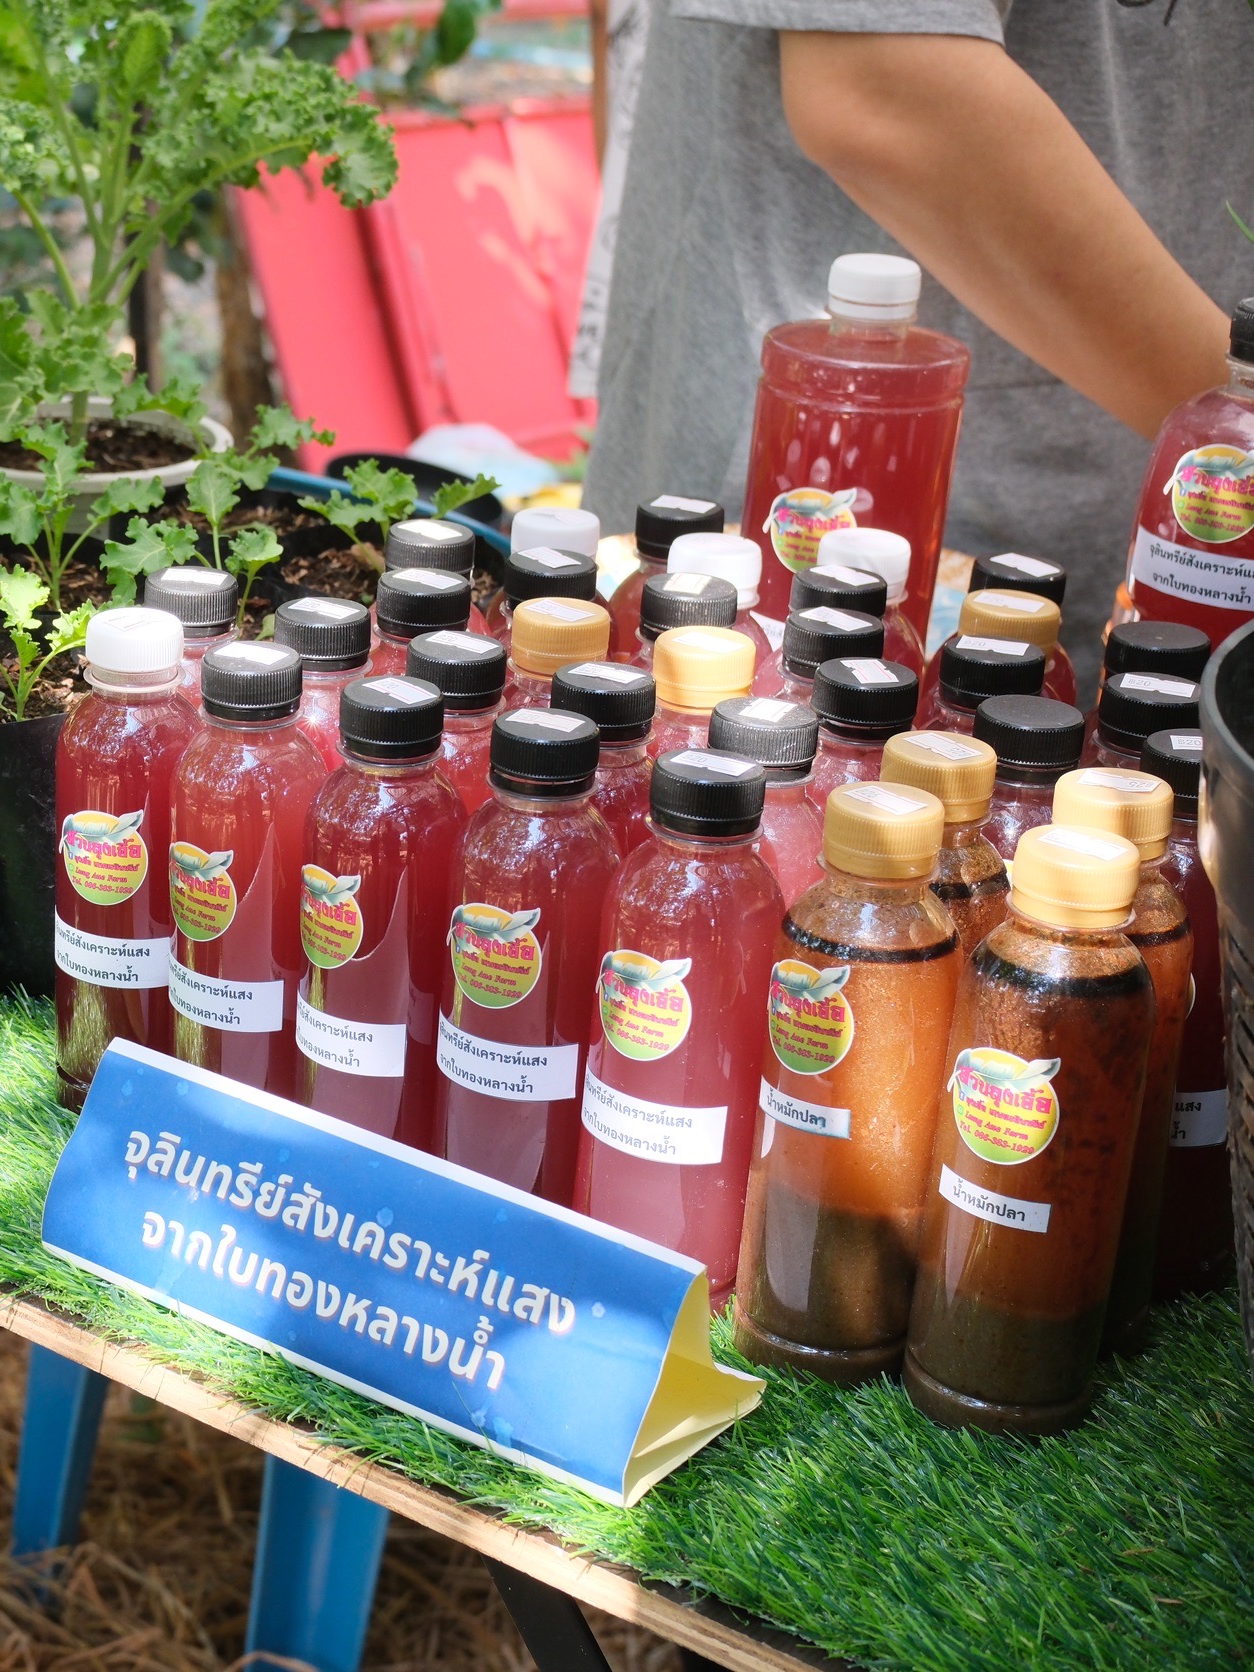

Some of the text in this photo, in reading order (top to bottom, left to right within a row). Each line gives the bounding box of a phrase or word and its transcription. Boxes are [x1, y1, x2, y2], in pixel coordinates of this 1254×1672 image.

[1150, 543, 1254, 579] จุลินทรีย์สังเคราะห์แ
[1175, 1102, 1201, 1111] แสง
[953, 1179, 1026, 1222] น้ำหมักปลา
[122, 1127, 577, 1337] จุลินทรีย์สังเคราะห์แสง
[140, 1208, 506, 1390] จากใบทองหลางน้ำ
